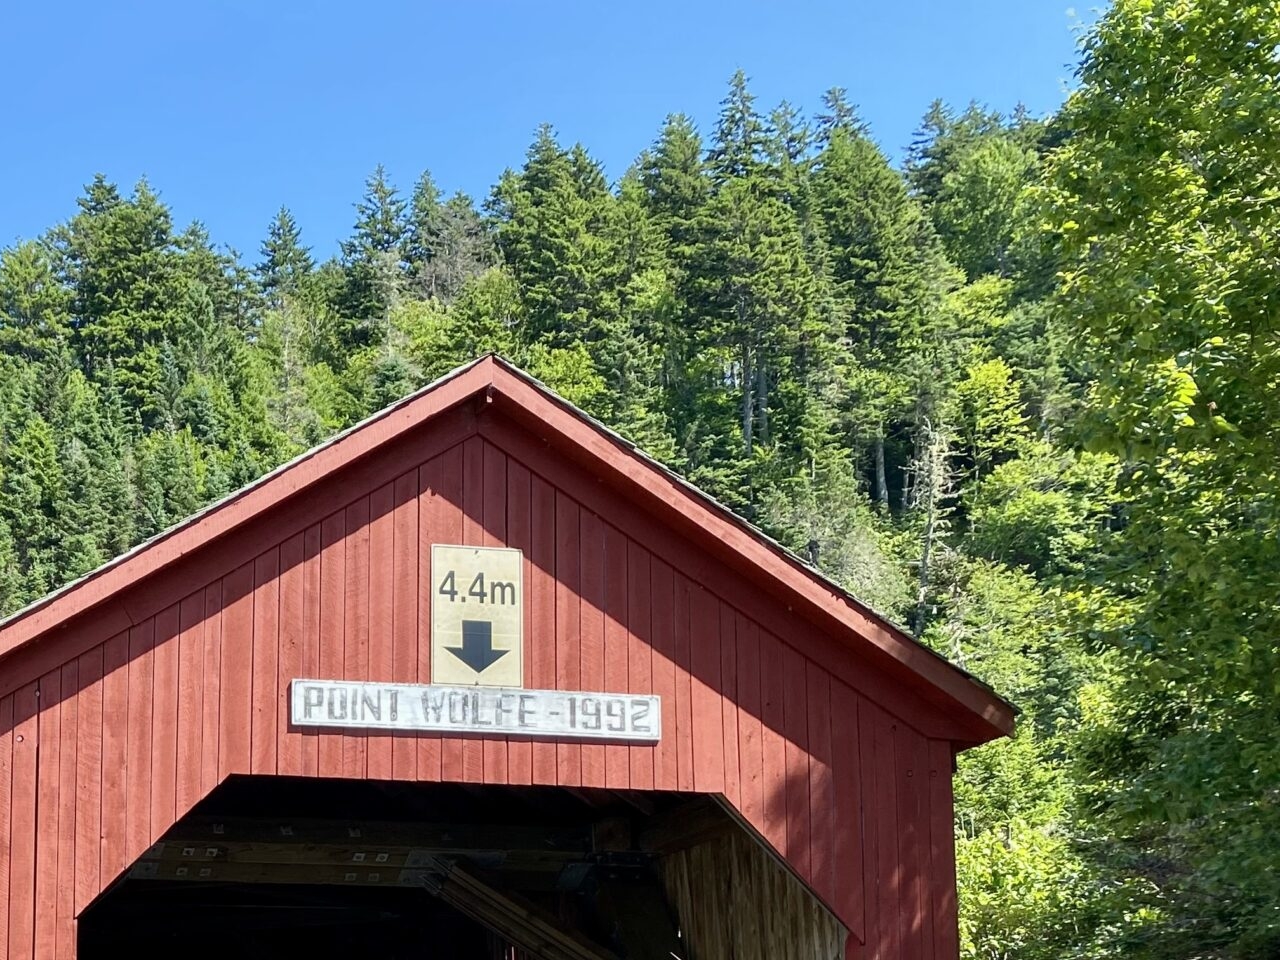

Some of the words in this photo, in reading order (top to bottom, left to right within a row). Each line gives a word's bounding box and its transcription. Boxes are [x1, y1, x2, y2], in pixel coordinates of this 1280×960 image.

[438, 570, 516, 606] 4.4m
[303, 686, 400, 722] POINT
[420, 690, 538, 728] WOLFE
